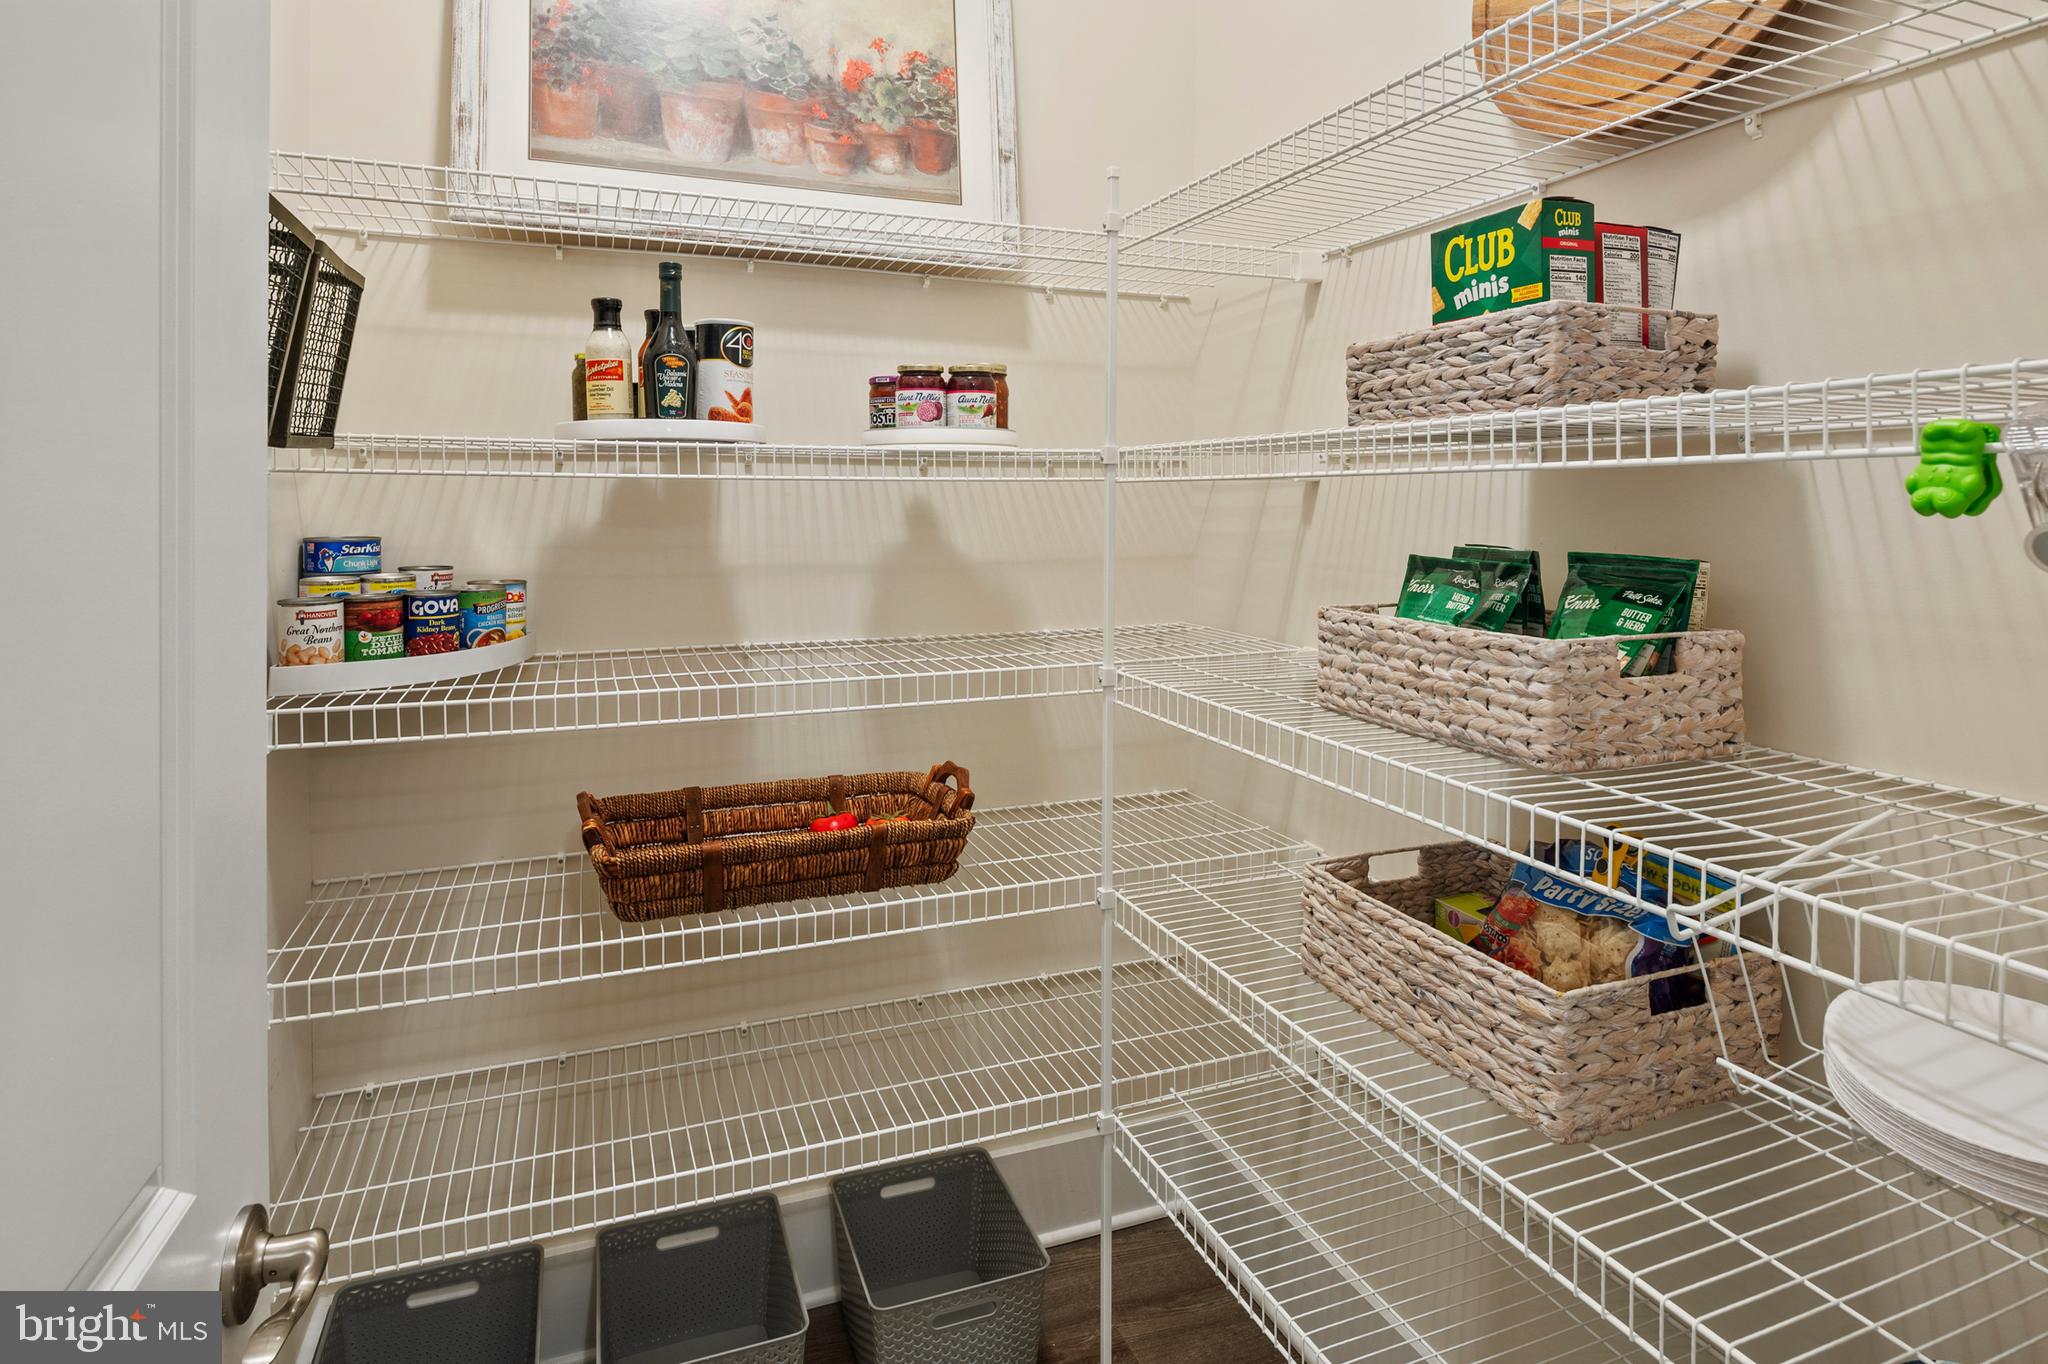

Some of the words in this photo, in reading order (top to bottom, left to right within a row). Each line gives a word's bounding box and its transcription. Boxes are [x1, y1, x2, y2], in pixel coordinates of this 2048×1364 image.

[1554, 208, 1582, 226] CLUB
[1558, 227, 1579, 237] minis
[1444, 227, 1516, 282] CLUB
[1453, 274, 1509, 310] minis
[897, 392, 914, 402] Aunt
[957, 394, 978, 403] Aunt
[507, 592, 525, 602] Dole
[1452, 592, 1470, 604] HERB
[1565, 594, 1601, 610] Knorr
[411, 598, 459, 616] GOYA
[1445, 600, 1471, 613] BUTTER
[304, 611, 338, 619] HANOVER
[1621, 607, 1653, 623] BUTTER
[286, 624, 309, 636] Great
[416, 626, 439, 634] Kidney
[1616, 618, 1624, 627] &
[1624, 619, 1646, 632] HERB
[303, 634, 332, 646] Beans
[1532, 875, 1597, 909] Party
